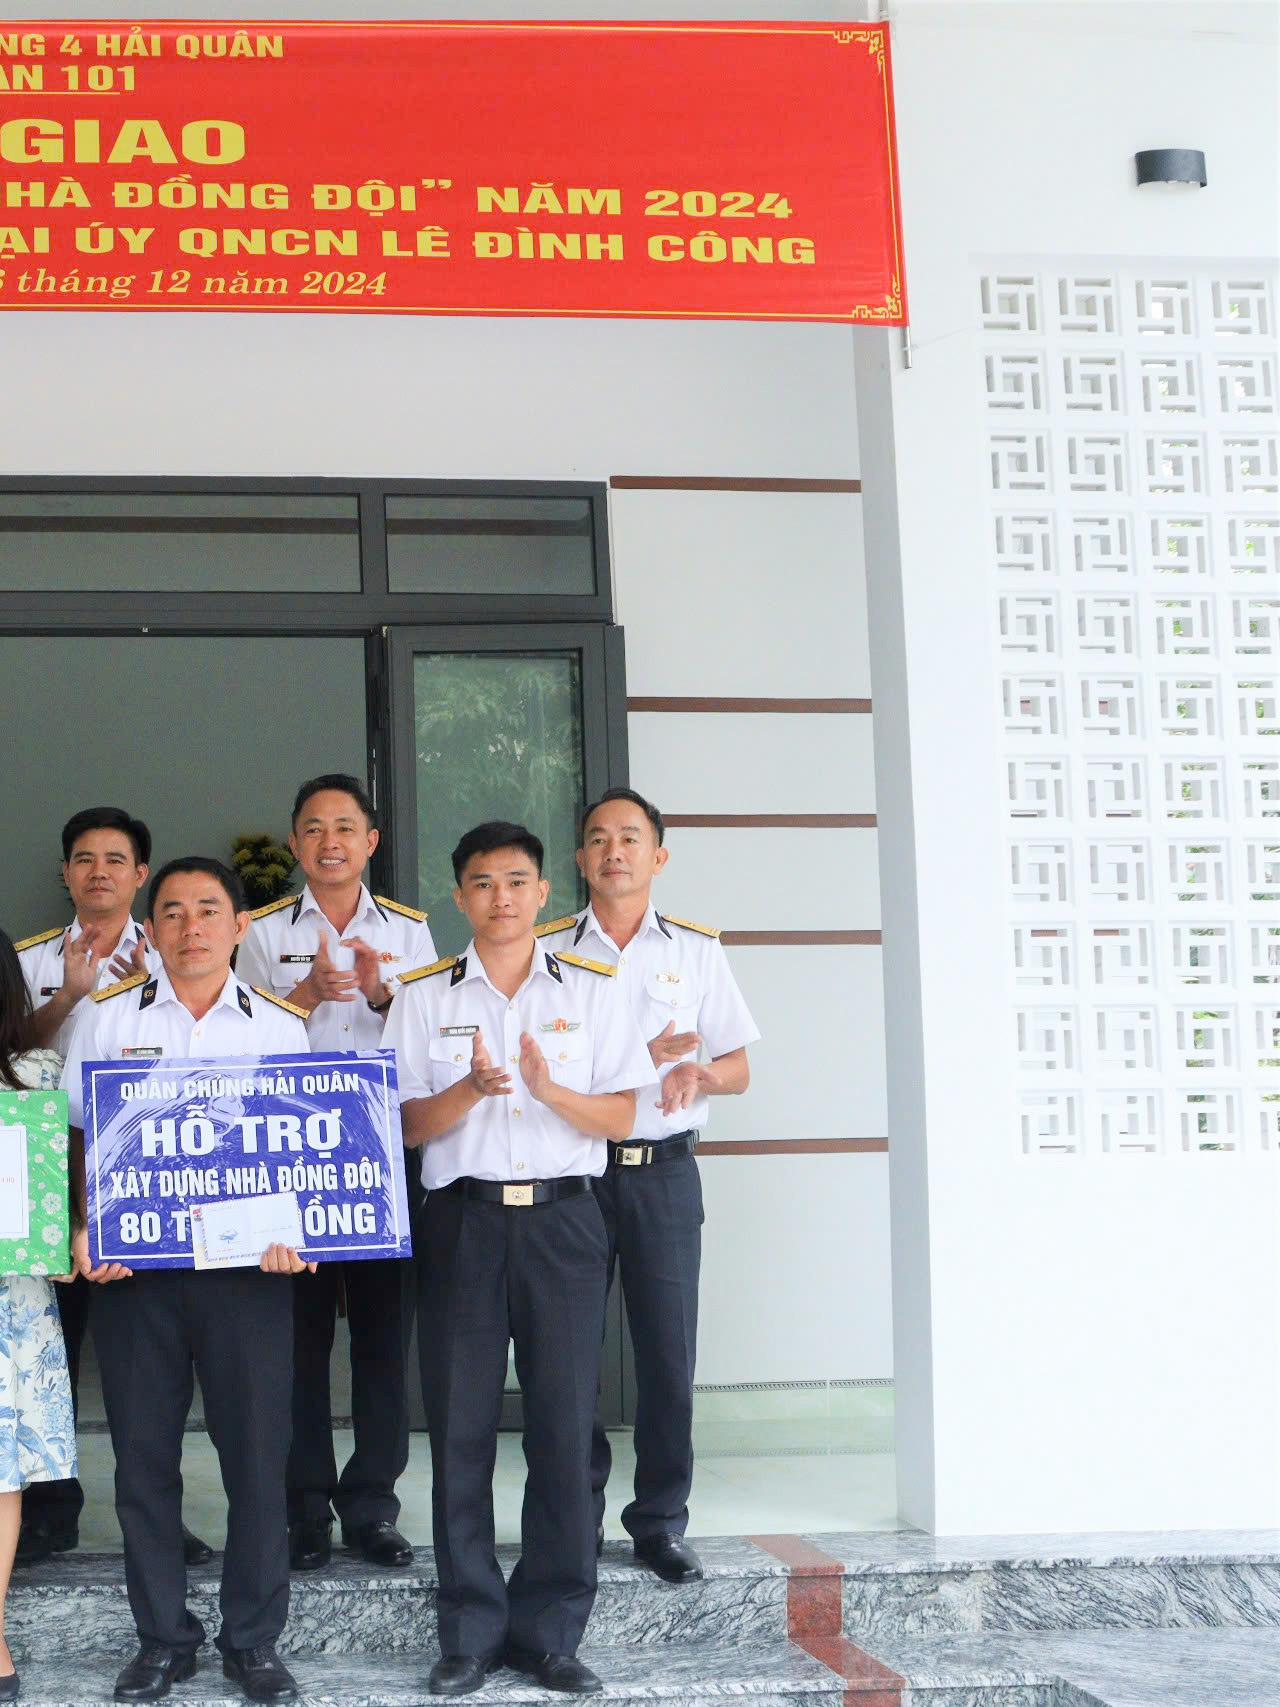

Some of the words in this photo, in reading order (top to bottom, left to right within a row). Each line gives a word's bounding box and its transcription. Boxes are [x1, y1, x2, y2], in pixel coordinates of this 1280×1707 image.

[59, 33, 83, 57] 4
[96, 26, 161, 57] HẢI
[175, 29, 284, 58] QUÂN
[61, 65, 135, 91] 101
[0, 118, 246, 165] GIAO
[111, 173, 289, 210] ĐỒNG
[476, 180, 622, 215] NĂM
[644, 189, 794, 219] 2024
[75, 221, 155, 255] ÚY
[178, 227, 358, 258] QNCN
[381, 226, 451, 258] LÊ
[471, 225, 624, 261] ĐÌNH
[647, 230, 816, 265] CÔNG
[17, 267, 137, 300] tháng
[146, 269, 192, 293] 12
[201, 270, 289, 294] năm
[299, 271, 387, 296] 2024
[120, 1078, 178, 1102] QUÂN
[183, 1073, 255, 1098] CHỦNG
[261, 1069, 296, 1096] HẢI
[302, 1070, 360, 1096] QUÂN
[140, 1103, 215, 1157] HỖ
[234, 1108, 342, 1159] TRỢ
[109, 1165, 153, 1199] XÂY
[159, 1167, 220, 1203] DỰNG
[225, 1161, 273, 1195] NHÀ
[276, 1155, 339, 1192] ĐỒNG
[343, 1156, 382, 1195] ĐỘI
[120, 1211, 162, 1244] 80
[303, 1194, 377, 1237] ỒNG
